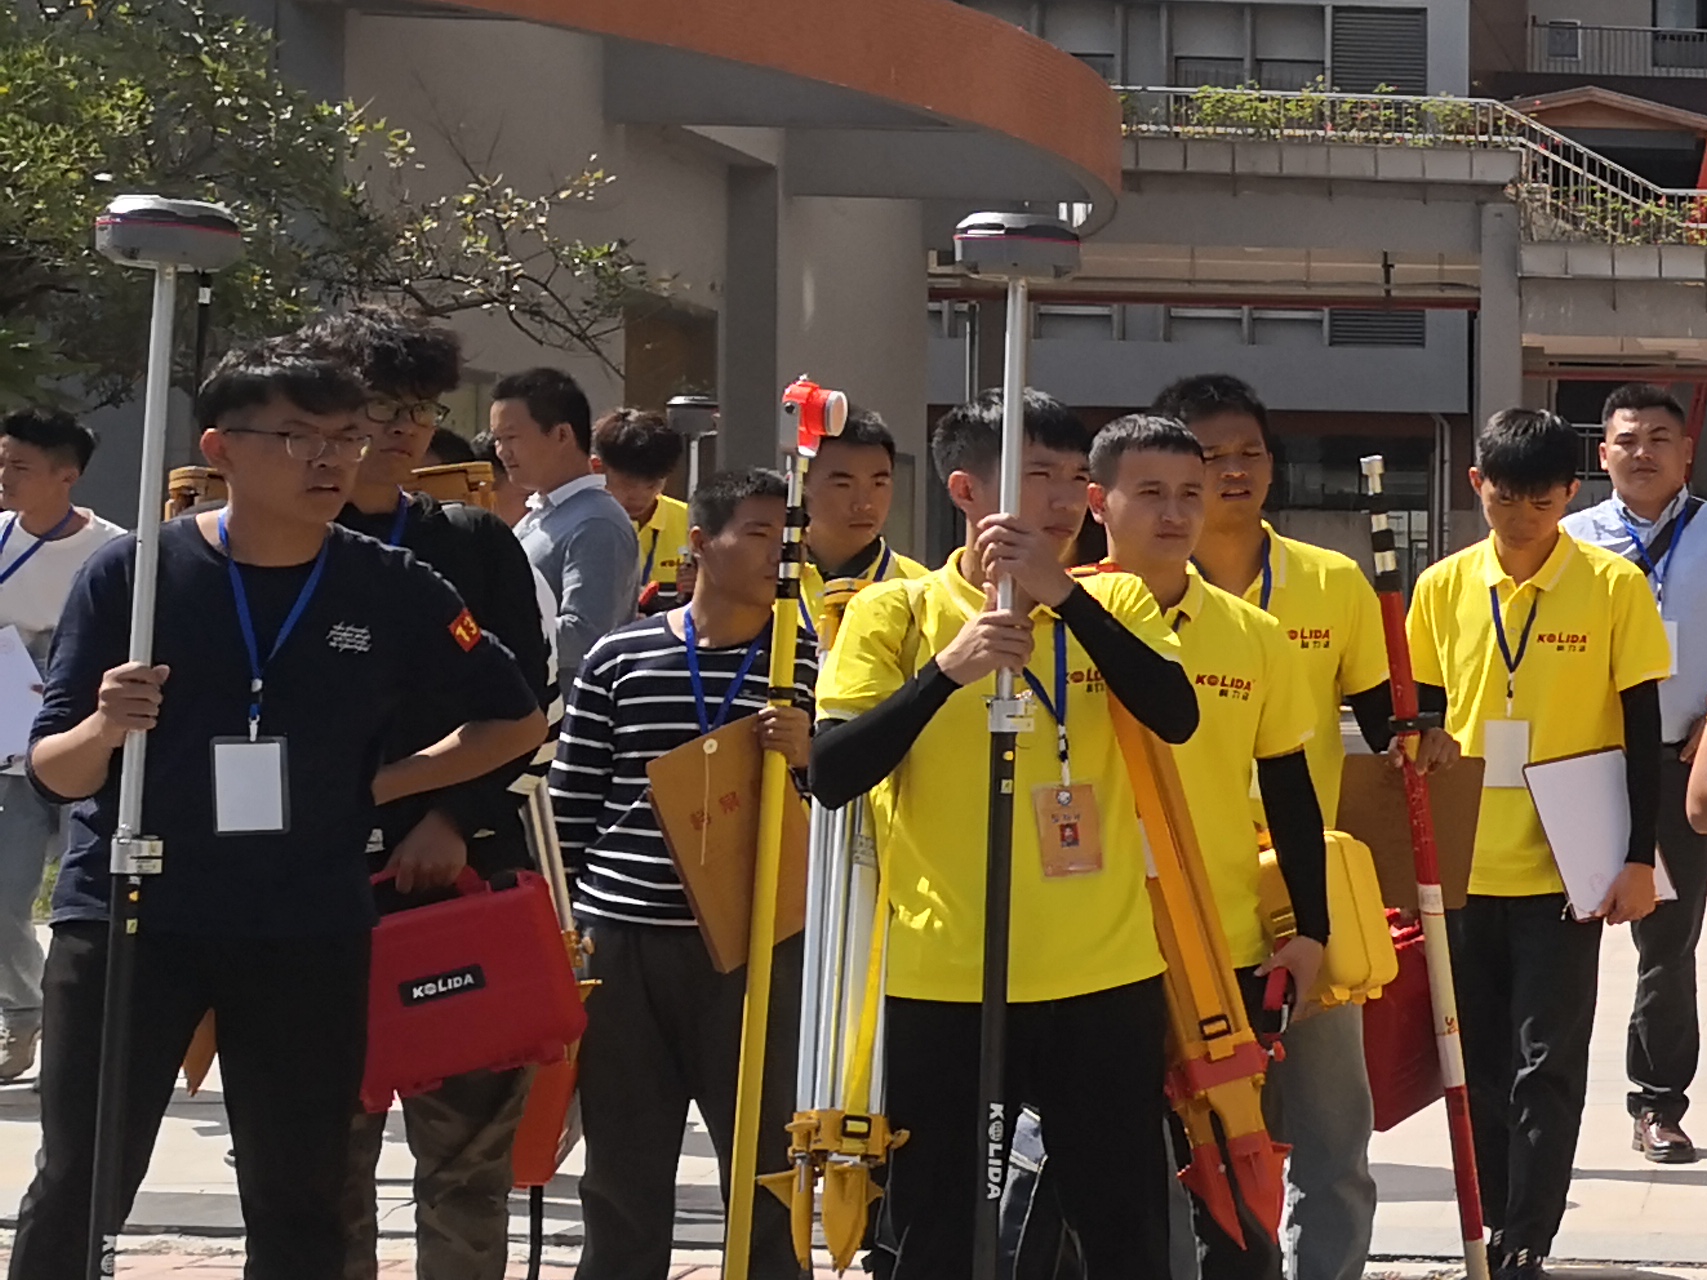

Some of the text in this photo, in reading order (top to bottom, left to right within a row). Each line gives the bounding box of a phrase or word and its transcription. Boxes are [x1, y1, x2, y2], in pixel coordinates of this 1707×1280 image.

[1537, 631, 1587, 644] KOLIDA
[1195, 673, 1252, 692] KOLIDA
[413, 973, 475, 1010] KOLIDA
[987, 1103, 1005, 1200] KOLIDA
